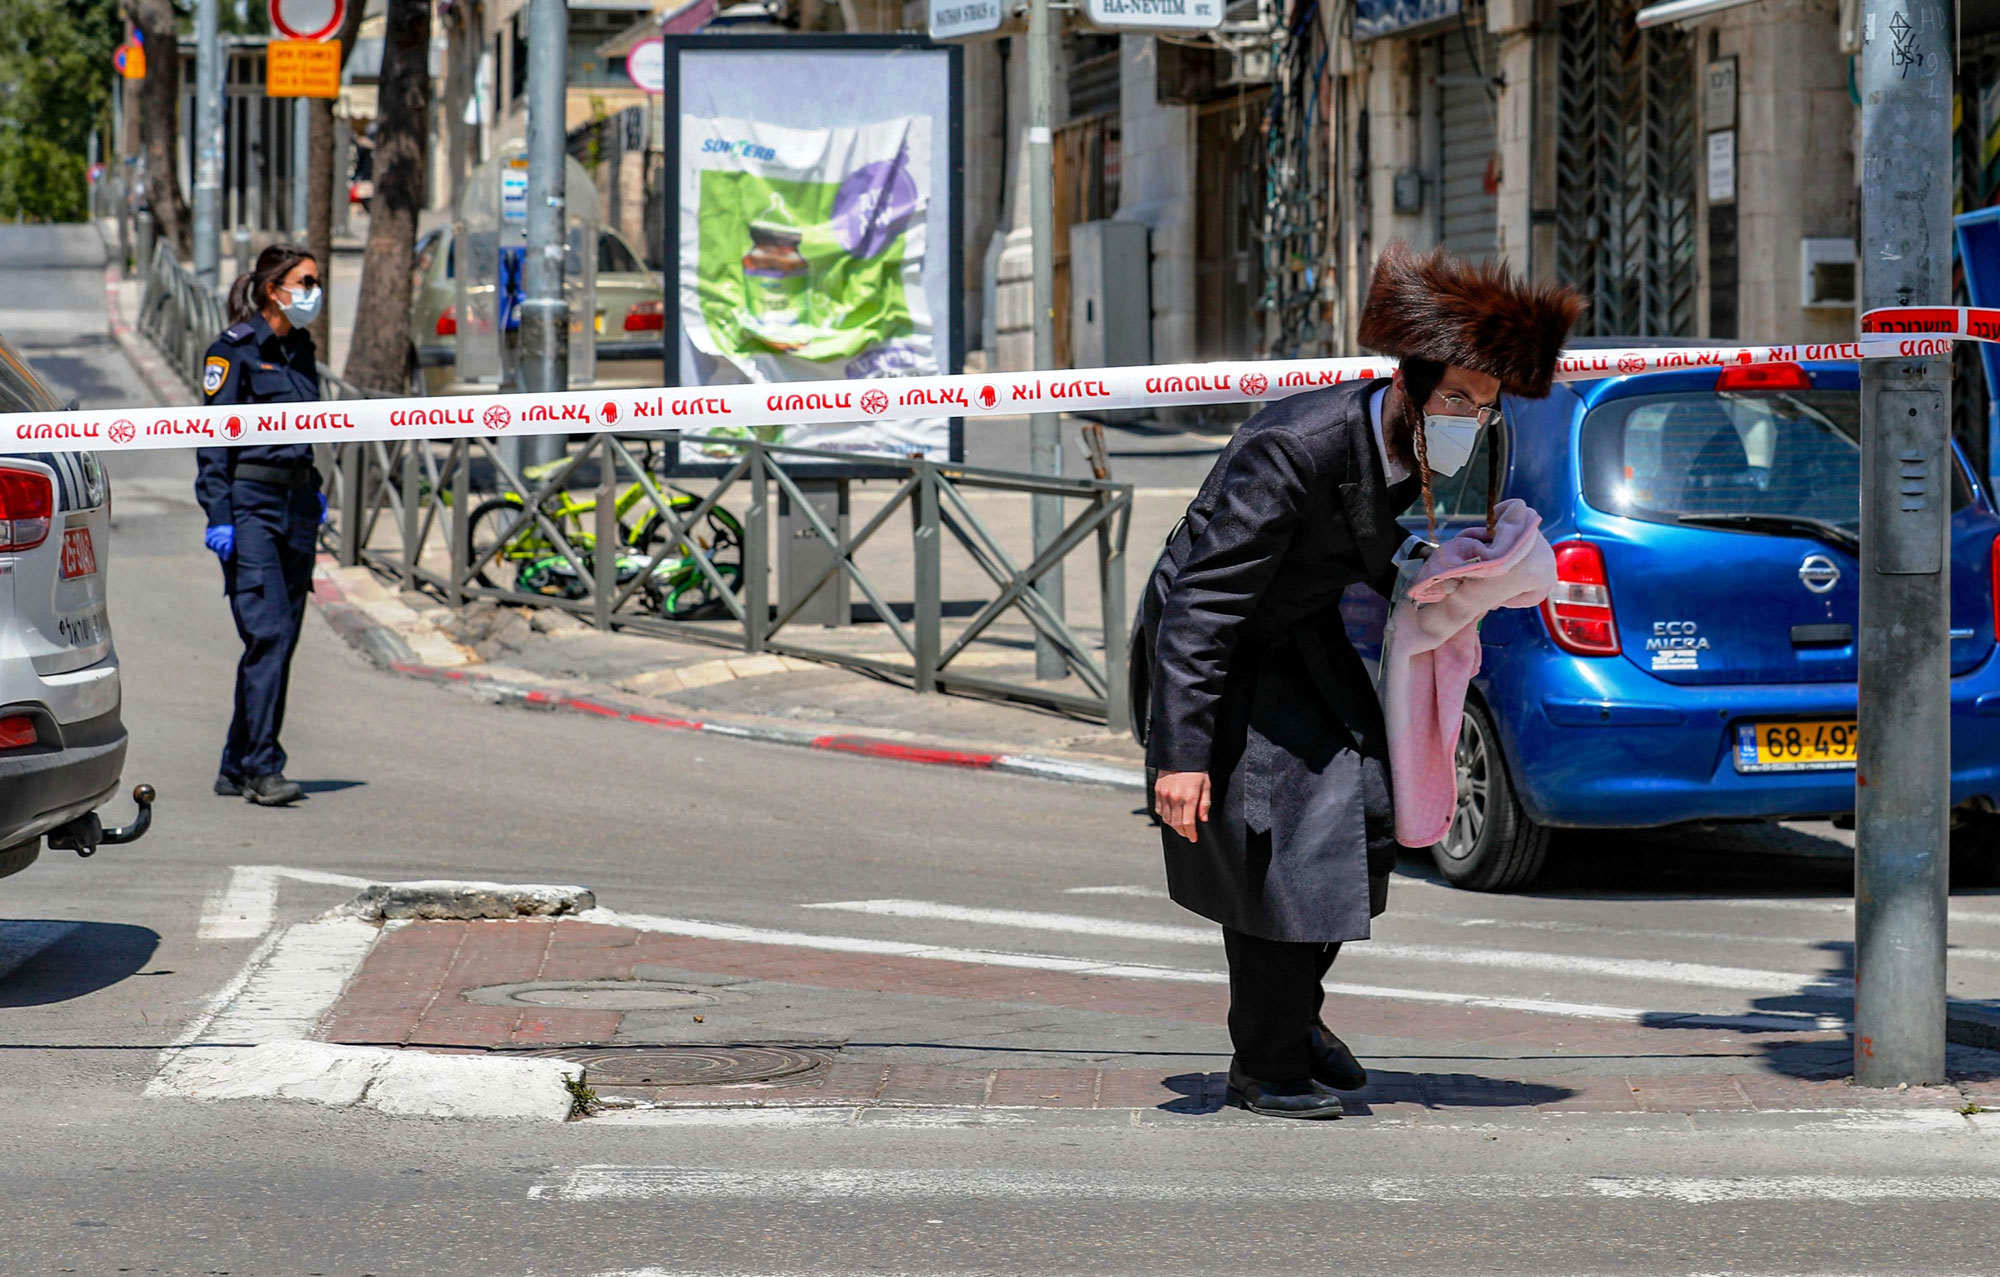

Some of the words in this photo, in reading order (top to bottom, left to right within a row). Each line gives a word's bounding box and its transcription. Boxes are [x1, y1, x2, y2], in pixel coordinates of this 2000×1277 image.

[1973, 321, 2000, 340] עבר
[1555, 355, 1609, 373] טרת
[1655, 350, 1725, 368] ישראל
[1767, 345, 1797, 362] אין
[1805, 343, 1865, 360] מעבר
[1899, 339, 1953, 357] משטר
[1145, 374, 1232, 394] משטרת
[1277, 369, 1345, 388] ישראל
[766, 391, 852, 412] משטרת
[898, 385, 969, 407] ישראל
[1011, 380, 1042, 401] אין
[1049, 379, 1111, 400] מעבר
[389, 407, 475, 427] משטרת
[521, 400, 591, 422] ישראל
[633, 397, 663, 417] אין
[671, 397, 732, 416] מעבר
[15, 423, 100, 440] משטרת
[145, 418, 215, 439] ישראל
[257, 411, 287, 432] אין
[295, 412, 355, 431] מעבר
[1653, 621, 1697, 635] ECO
[1645, 637, 1711, 650] MICRA
